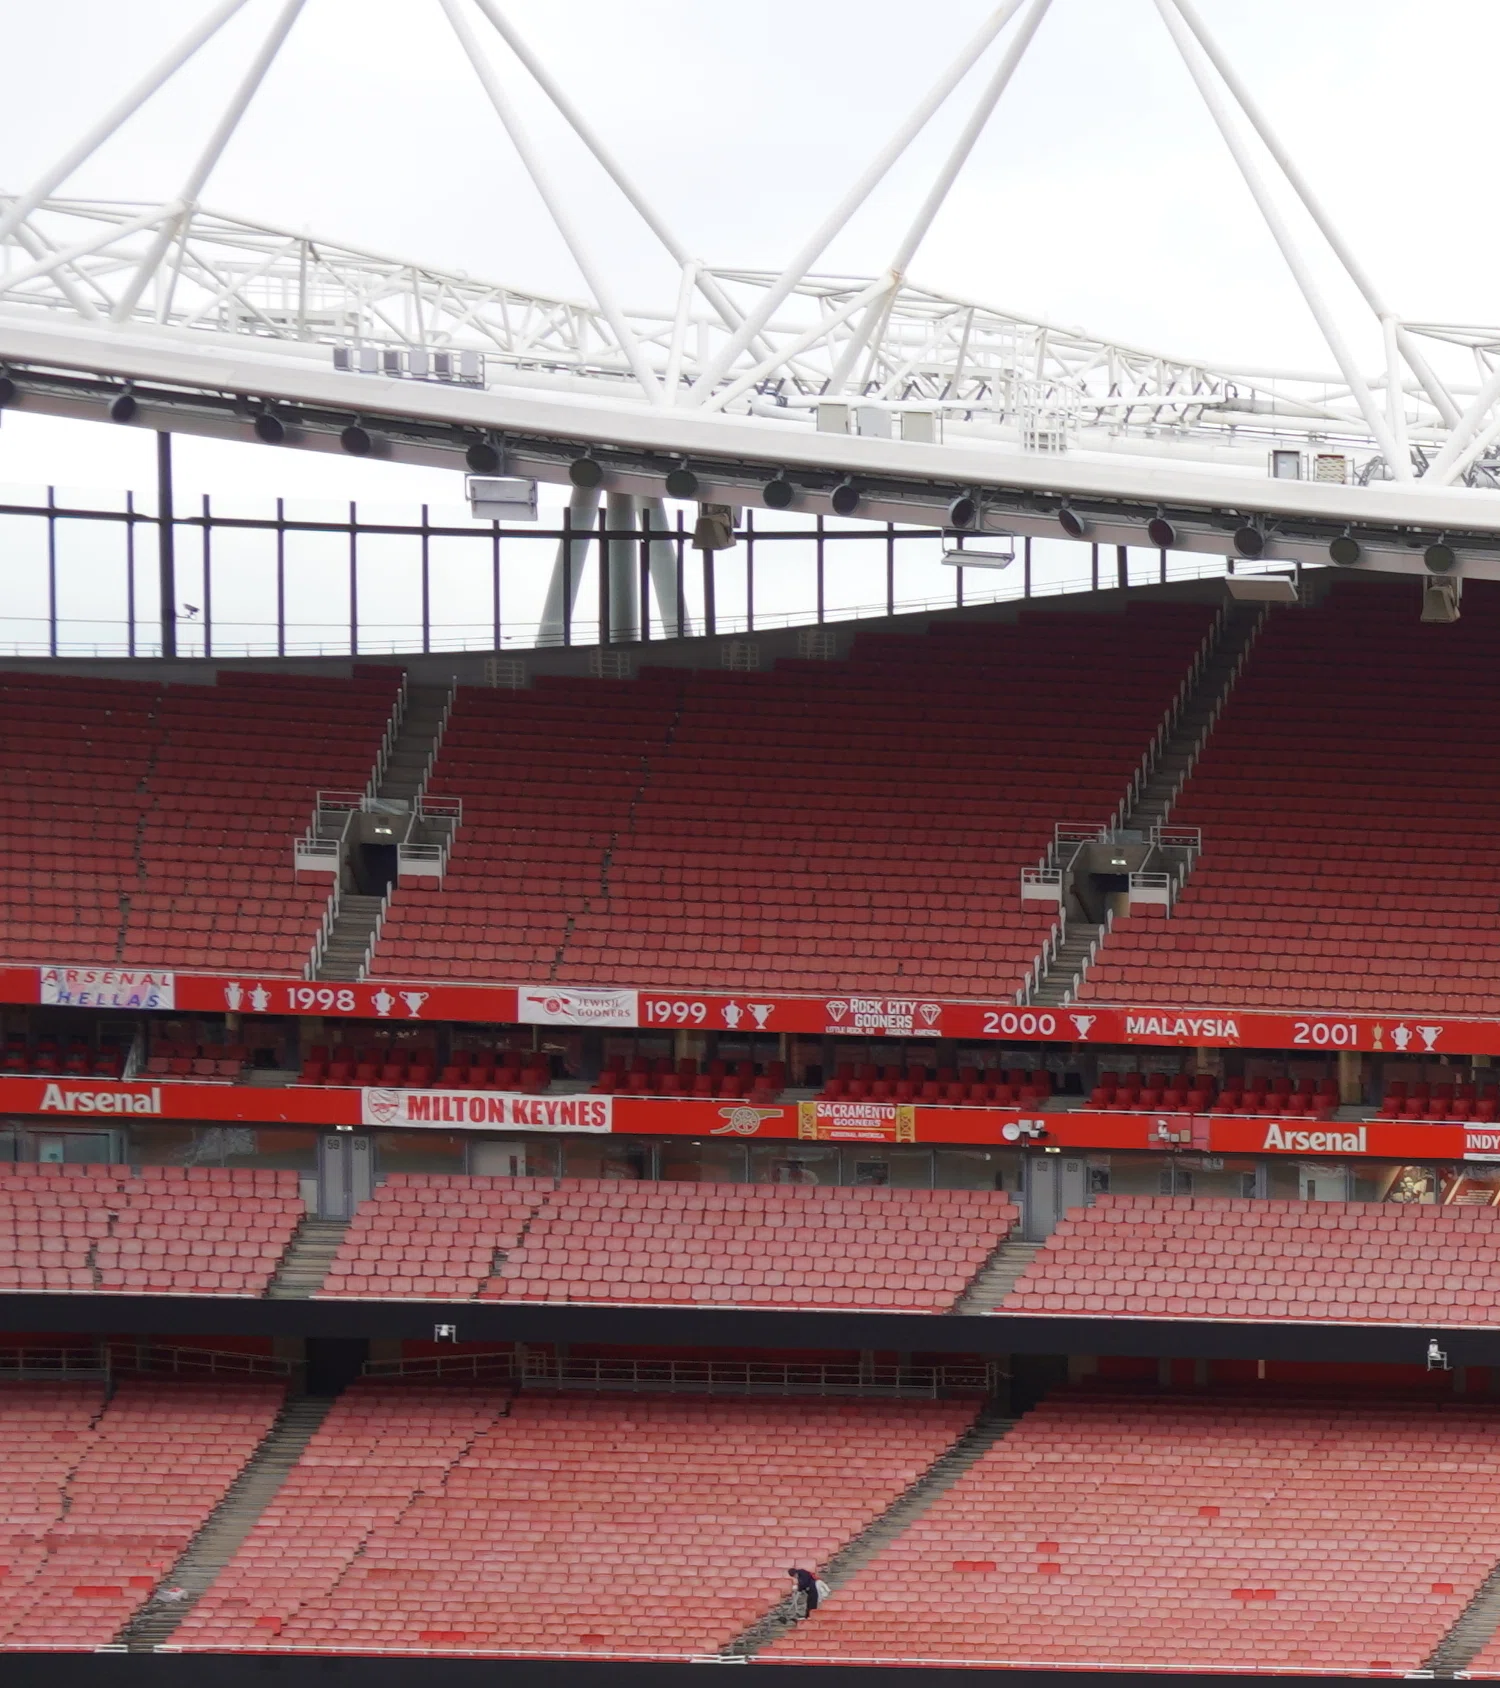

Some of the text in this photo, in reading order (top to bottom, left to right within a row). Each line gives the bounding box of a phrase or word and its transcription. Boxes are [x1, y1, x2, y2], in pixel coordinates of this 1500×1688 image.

[44, 969, 170, 987] ARSENAL
[56, 990, 160, 1008] HELLAS
[287, 987, 356, 1012] 1998
[850, 998, 917, 1015] ROCK CITY
[577, 1008, 631, 1018] GOONERS
[645, 1000, 707, 1024] 1999
[854, 1014, 913, 1029] GOONERS
[983, 1012, 1056, 1036] 2000
[1126, 1015, 1240, 1038] MALAYSIA
[1293, 1021, 1358, 1046] 2001
[39, 1083, 162, 1114] Arsenal
[407, 1095, 607, 1128] MILTON KEYNES
[816, 1103, 896, 1120] SACRAMENTO
[833, 1118, 882, 1127] GOONERS
[1262, 1123, 1367, 1153] Arsenal
